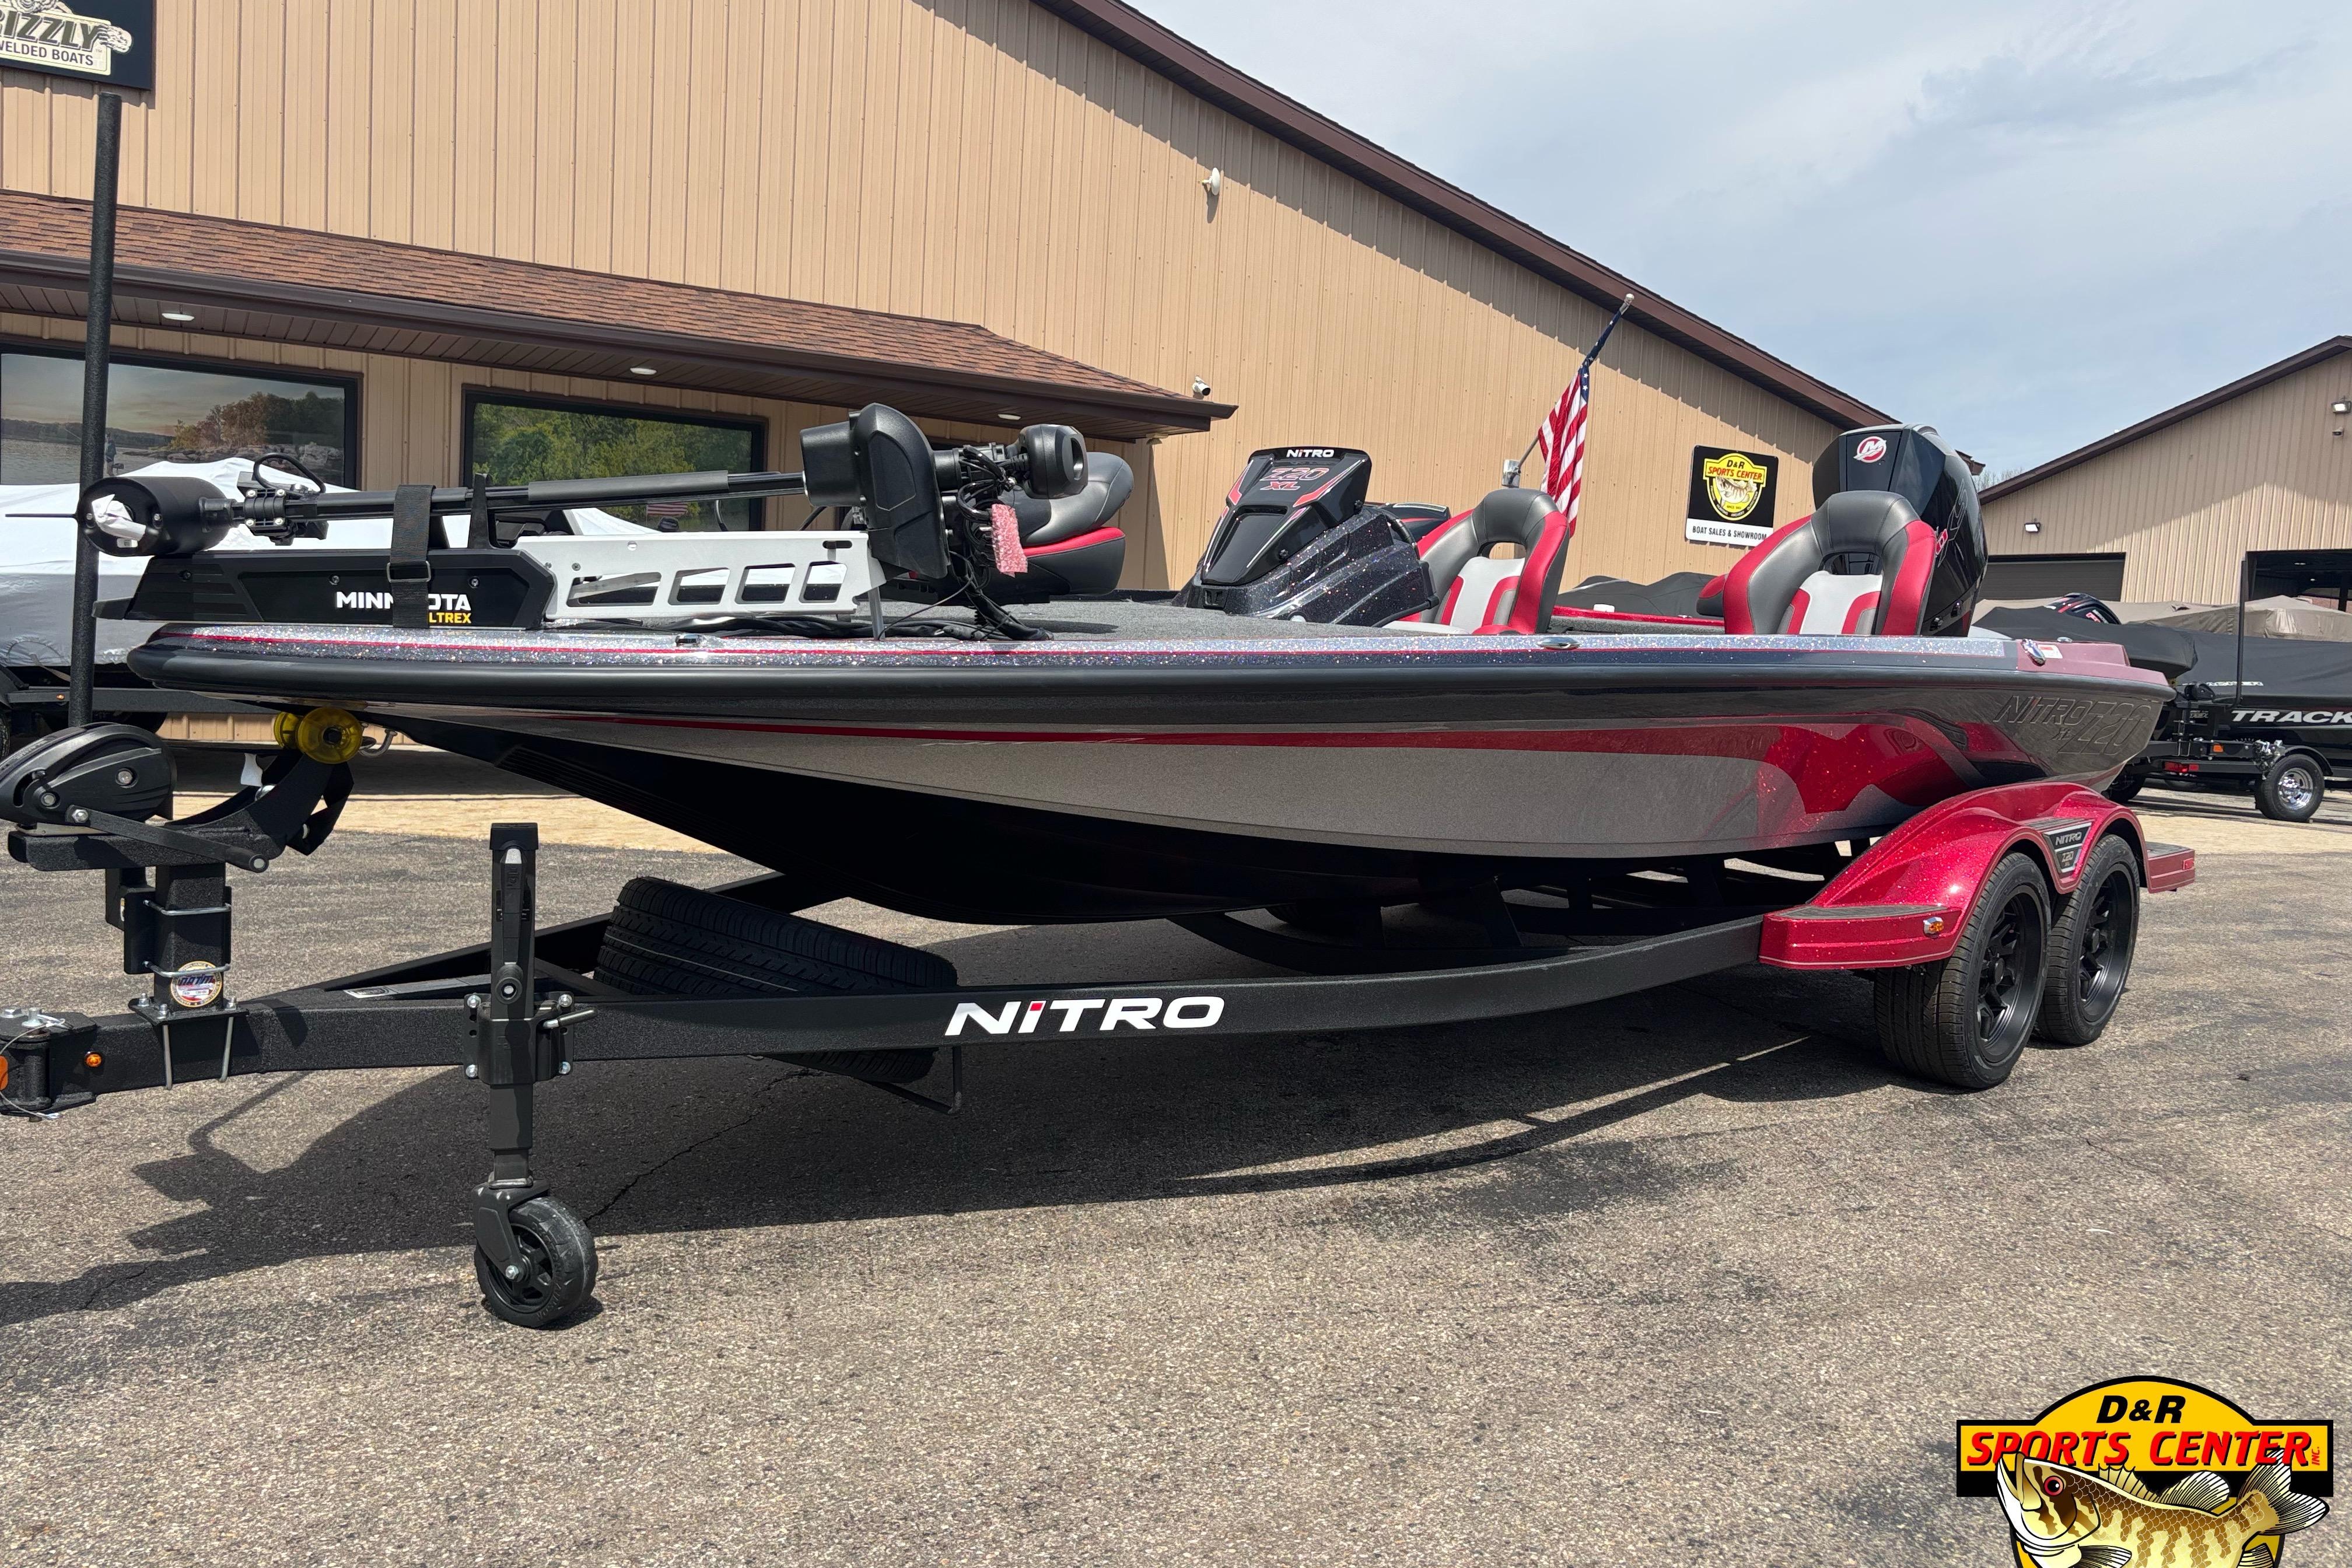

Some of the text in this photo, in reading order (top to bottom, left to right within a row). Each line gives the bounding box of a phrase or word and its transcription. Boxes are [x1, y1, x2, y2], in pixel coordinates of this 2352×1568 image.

[52, 50, 93, 66] BOATS
[1727, 460, 1745, 469] D&R
[1259, 467, 1329, 481] Z20
[1708, 467, 1762, 480] SPORTS CENTER
[1260, 481, 1301, 491] XL
[1692, 526, 1707, 534] BOAT
[1709, 527, 1726, 536] SALES
[1733, 530, 1767, 541] SHOWROOM
[428, 593, 471, 611] OTA
[429, 612, 471, 624] LTREX
[2055, 831, 2082, 845] NITRO
